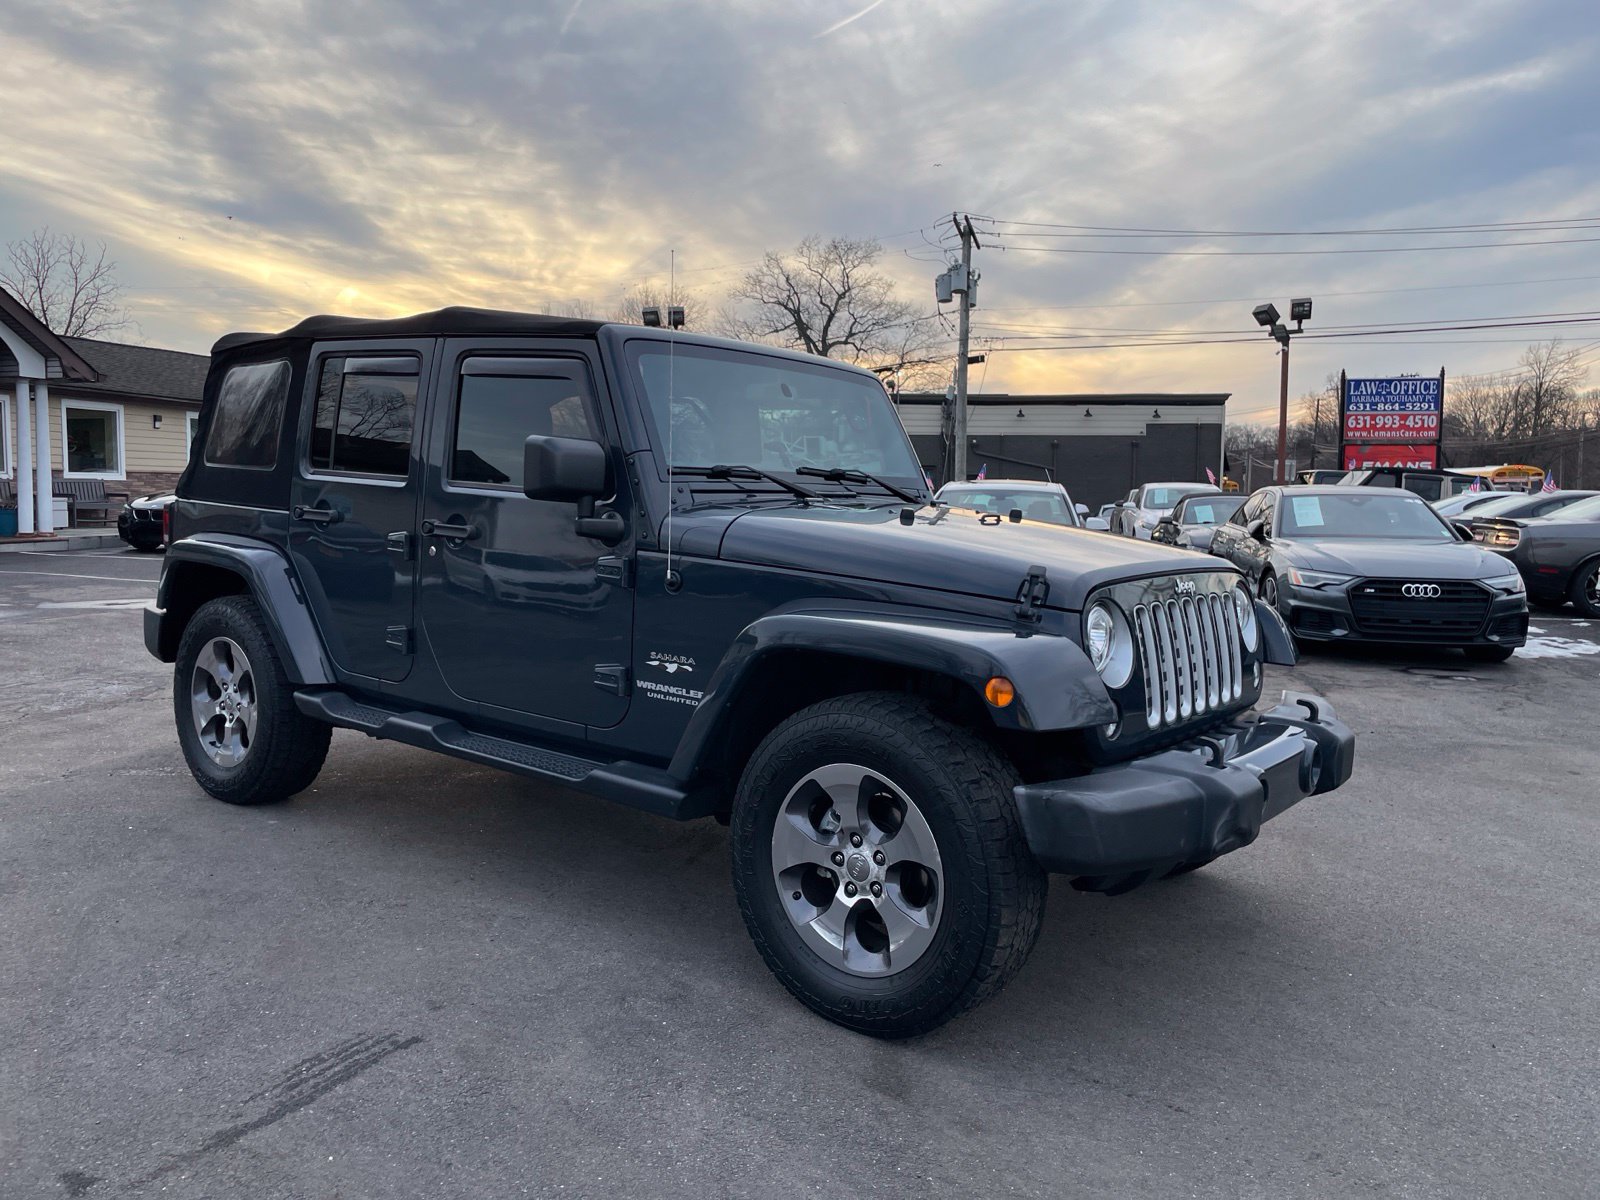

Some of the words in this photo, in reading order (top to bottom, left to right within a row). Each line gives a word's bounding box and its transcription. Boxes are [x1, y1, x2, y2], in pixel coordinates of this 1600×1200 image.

[1350, 382, 1379, 395] LAW
[1391, 381, 1437, 395] OFFICE
[1351, 395, 1385, 403] BARBARA
[1349, 403, 1435, 411] 631-864-5291
[1348, 415, 1437, 428] 631-993-4510
[1175, 579, 1196, 596] Jeep
[650, 651, 696, 665] SAHARA
[647, 691, 699, 706] UNLIMITED
